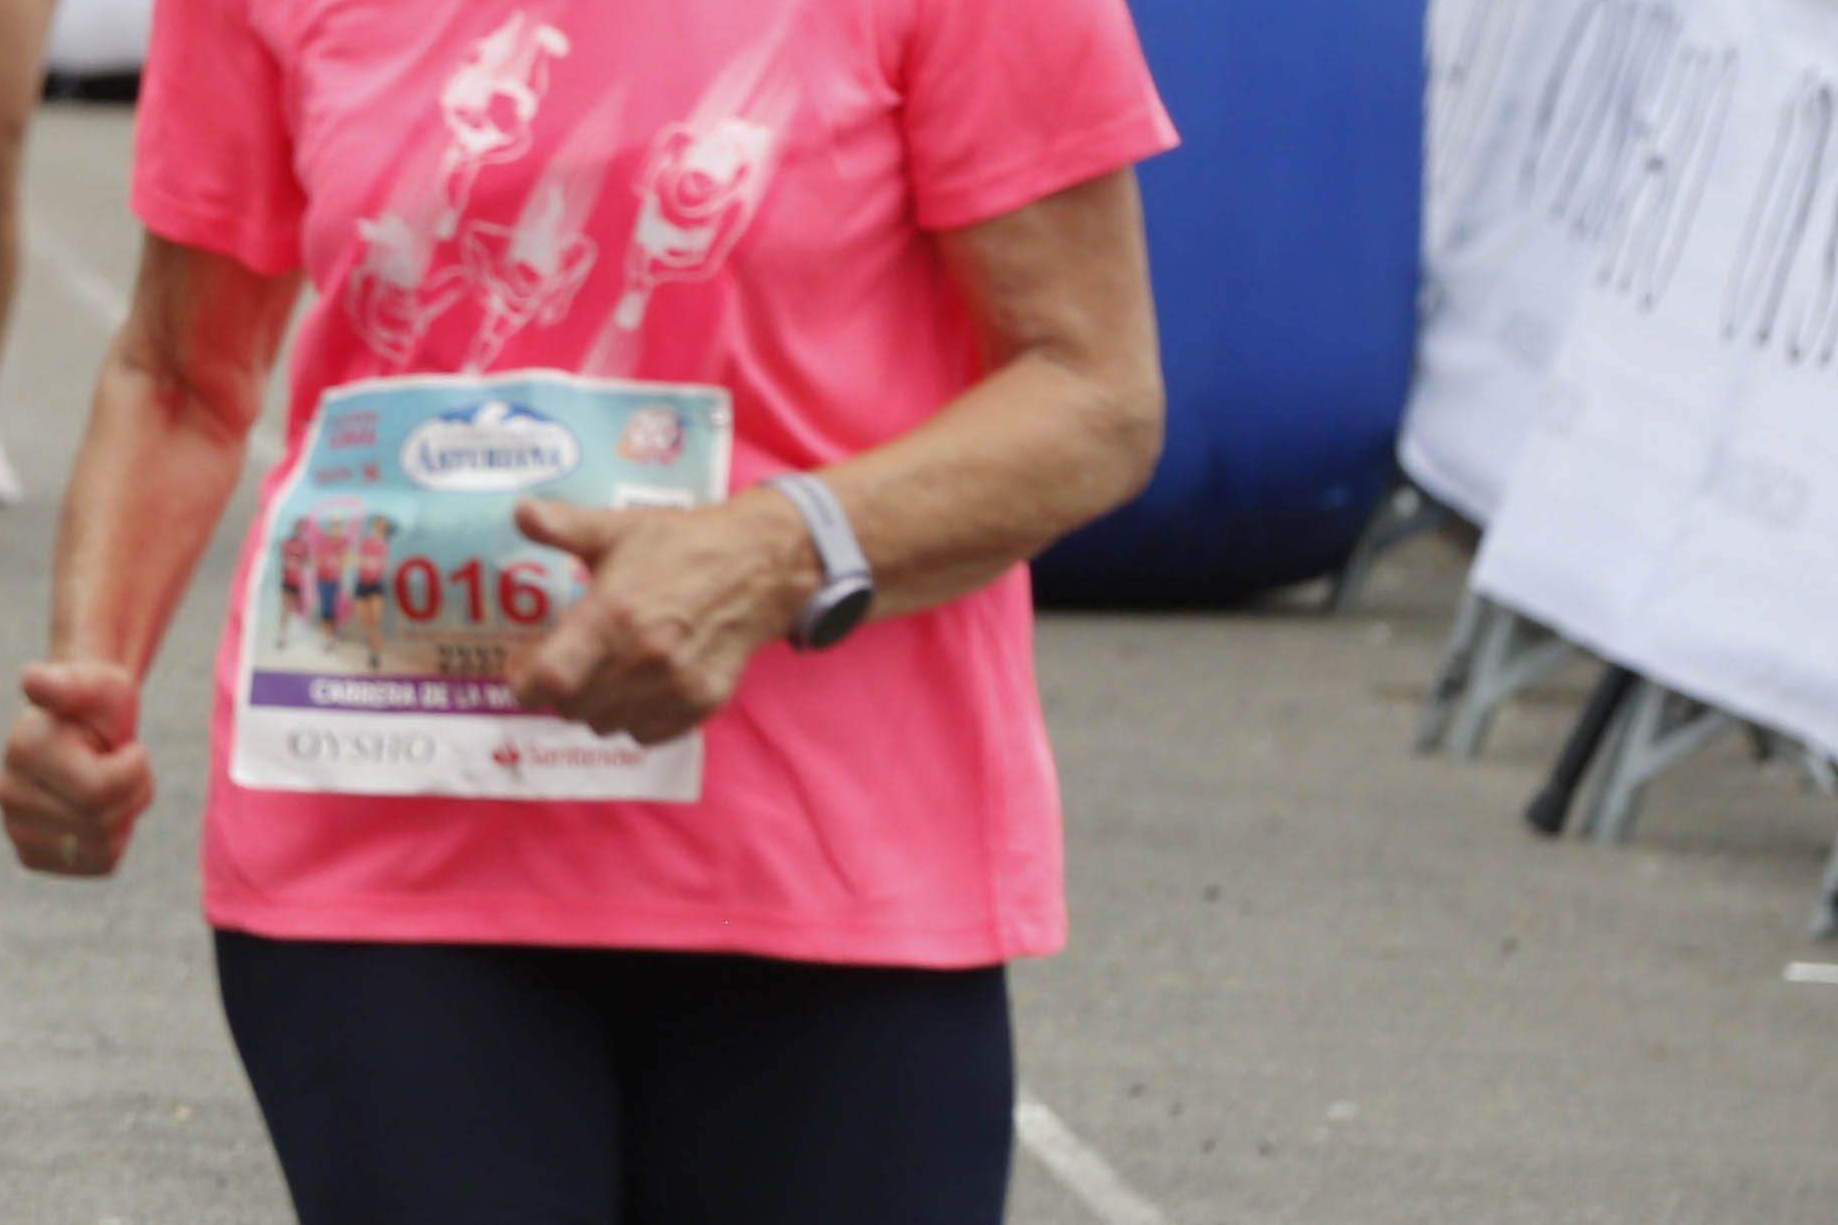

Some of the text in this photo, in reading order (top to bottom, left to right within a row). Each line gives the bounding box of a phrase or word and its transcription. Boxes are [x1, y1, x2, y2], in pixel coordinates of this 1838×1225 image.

[393, 554, 551, 625] 016
[309, 678, 417, 708] CARRERA
[419, 680, 450, 710] DE
[455, 681, 481, 711] LA
[288, 731, 436, 764] OYSHO
